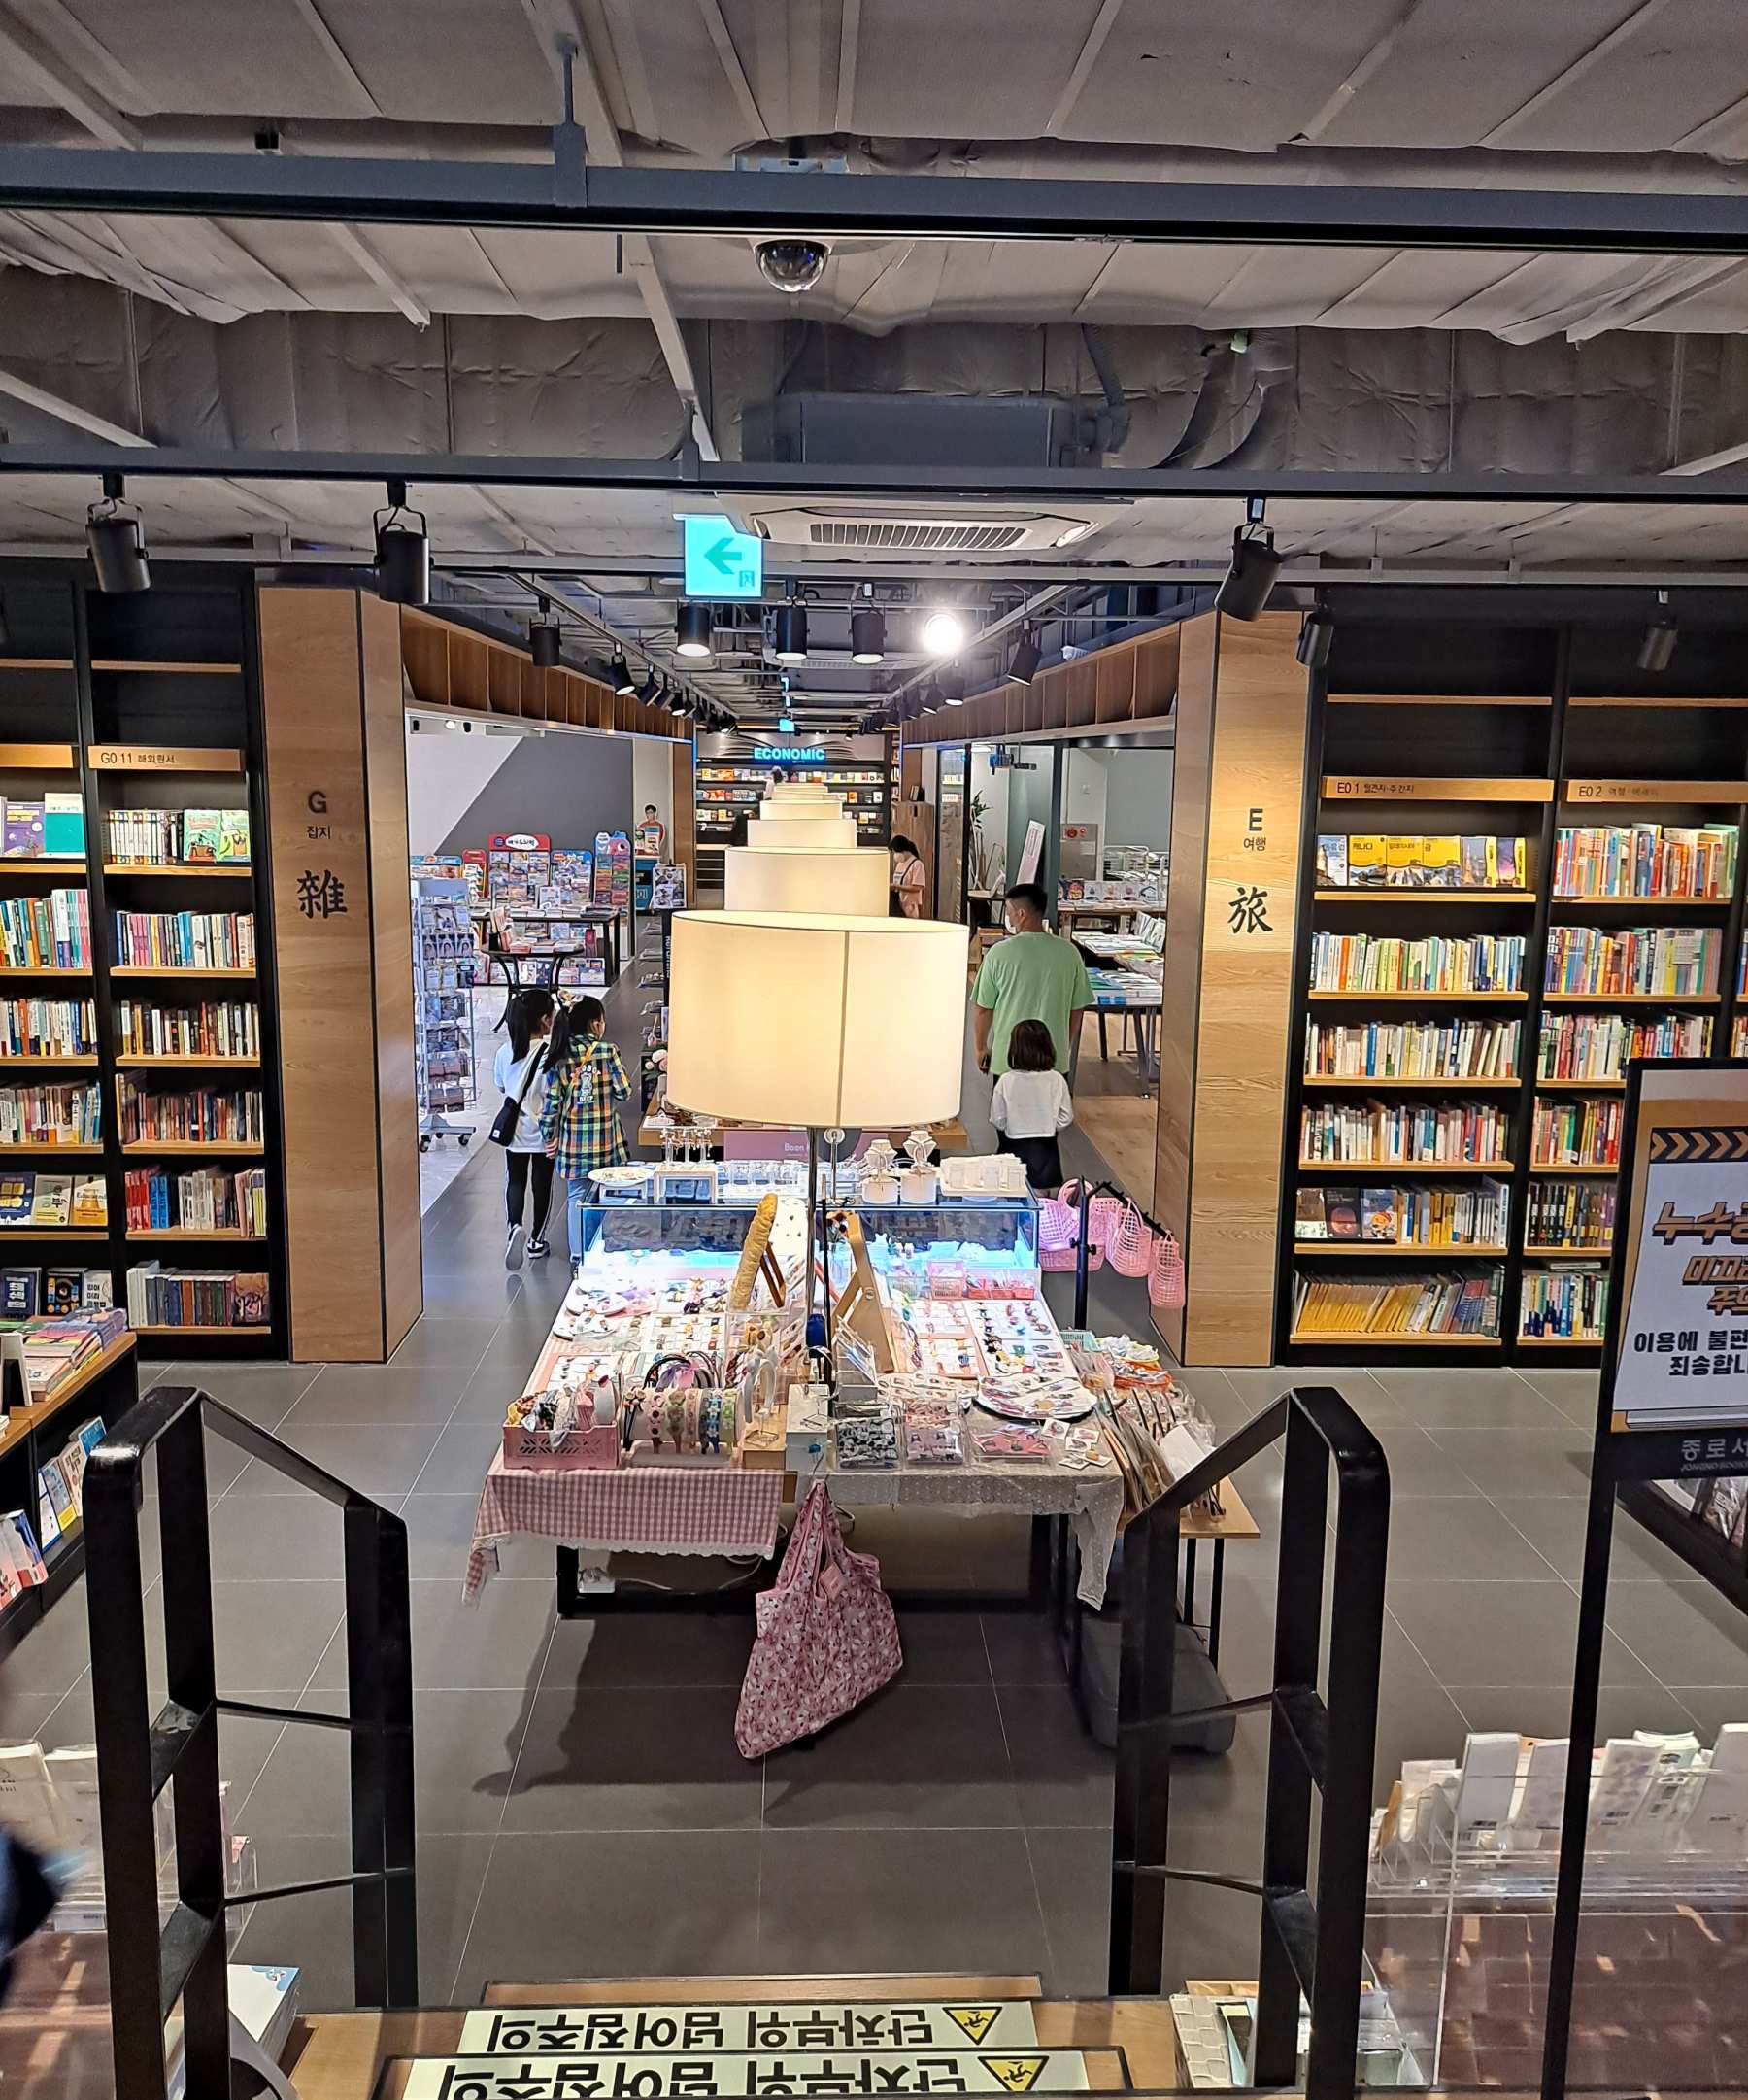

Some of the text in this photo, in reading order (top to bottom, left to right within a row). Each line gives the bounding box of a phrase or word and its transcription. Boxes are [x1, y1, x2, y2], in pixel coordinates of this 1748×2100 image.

[754, 748, 825, 760] ECONOMIC
[307, 791, 327, 814] G
[1249, 808, 1263, 831] E
[307, 825, 331, 840] 잡지
[1243, 837, 1266, 852] 여행
[1227, 886, 1274, 934] 旅
[1633, 1331, 1699, 1353] 이용에
[487, 2009, 933, 2052] 단차부위 넘어짐주의
